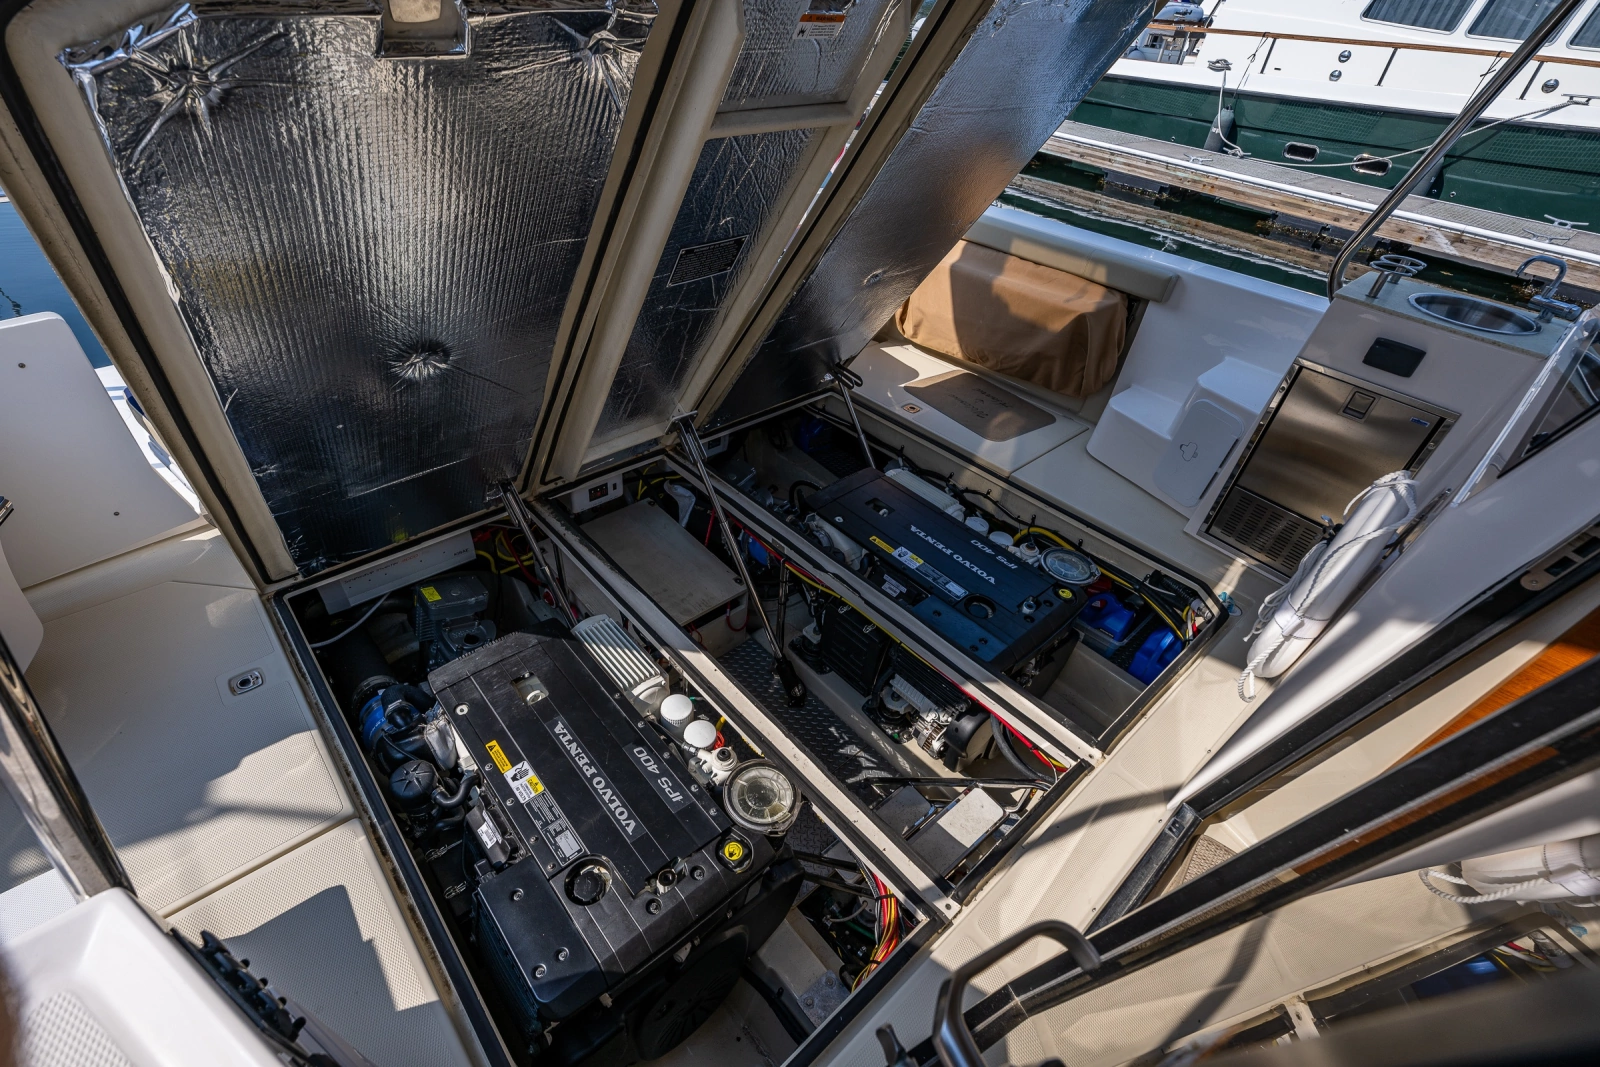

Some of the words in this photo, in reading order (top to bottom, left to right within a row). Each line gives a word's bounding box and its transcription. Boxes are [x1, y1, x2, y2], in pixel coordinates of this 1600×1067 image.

[910, 524, 954, 556] PENTA
[970, 540, 996, 554] 400
[952, 554, 996, 584] VOLVO
[996, 556, 1018, 570] IPS
[554, 721, 598, 778] PENTA
[633, 746, 660, 774] 400
[658, 776, 684, 802] IPS
[592, 776, 636, 836] VOLVO
